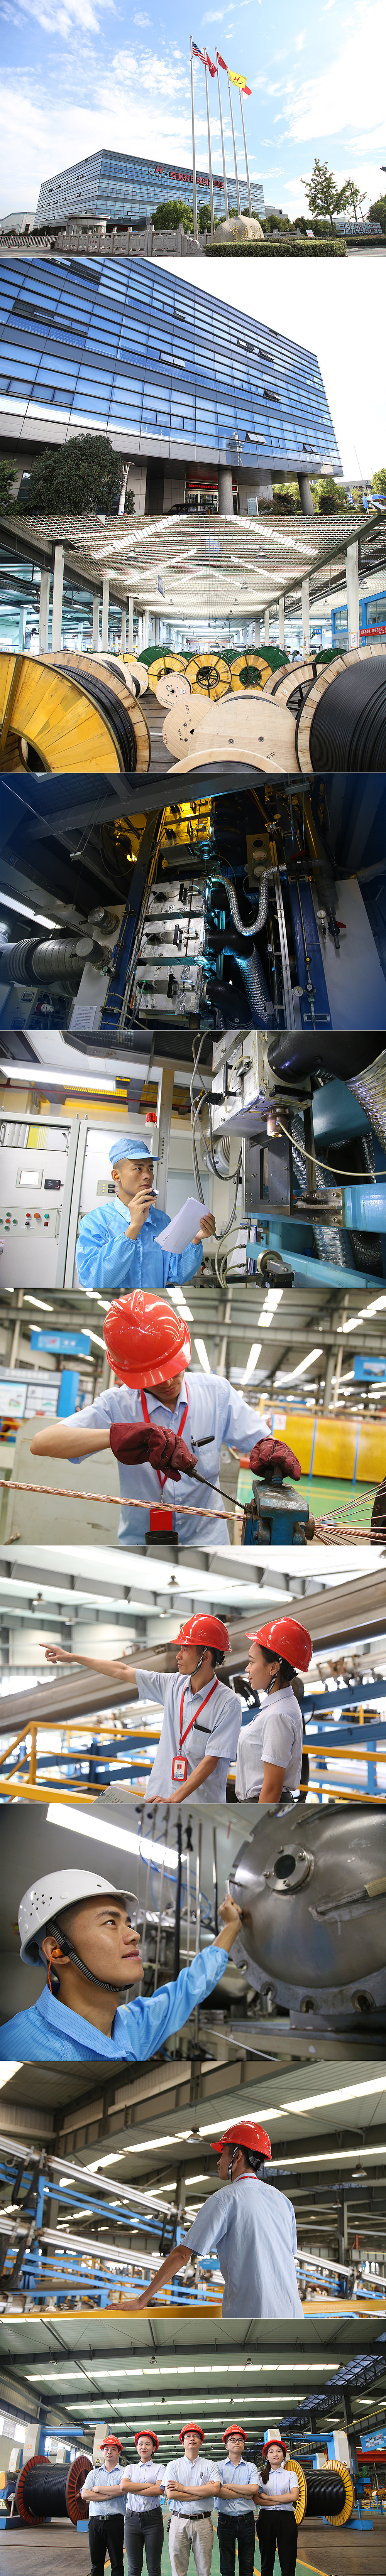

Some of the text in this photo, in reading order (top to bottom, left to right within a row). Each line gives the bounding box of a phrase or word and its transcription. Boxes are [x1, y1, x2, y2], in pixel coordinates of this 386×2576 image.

[339, 222, 383, 234] 亨通光电线缆产业园
